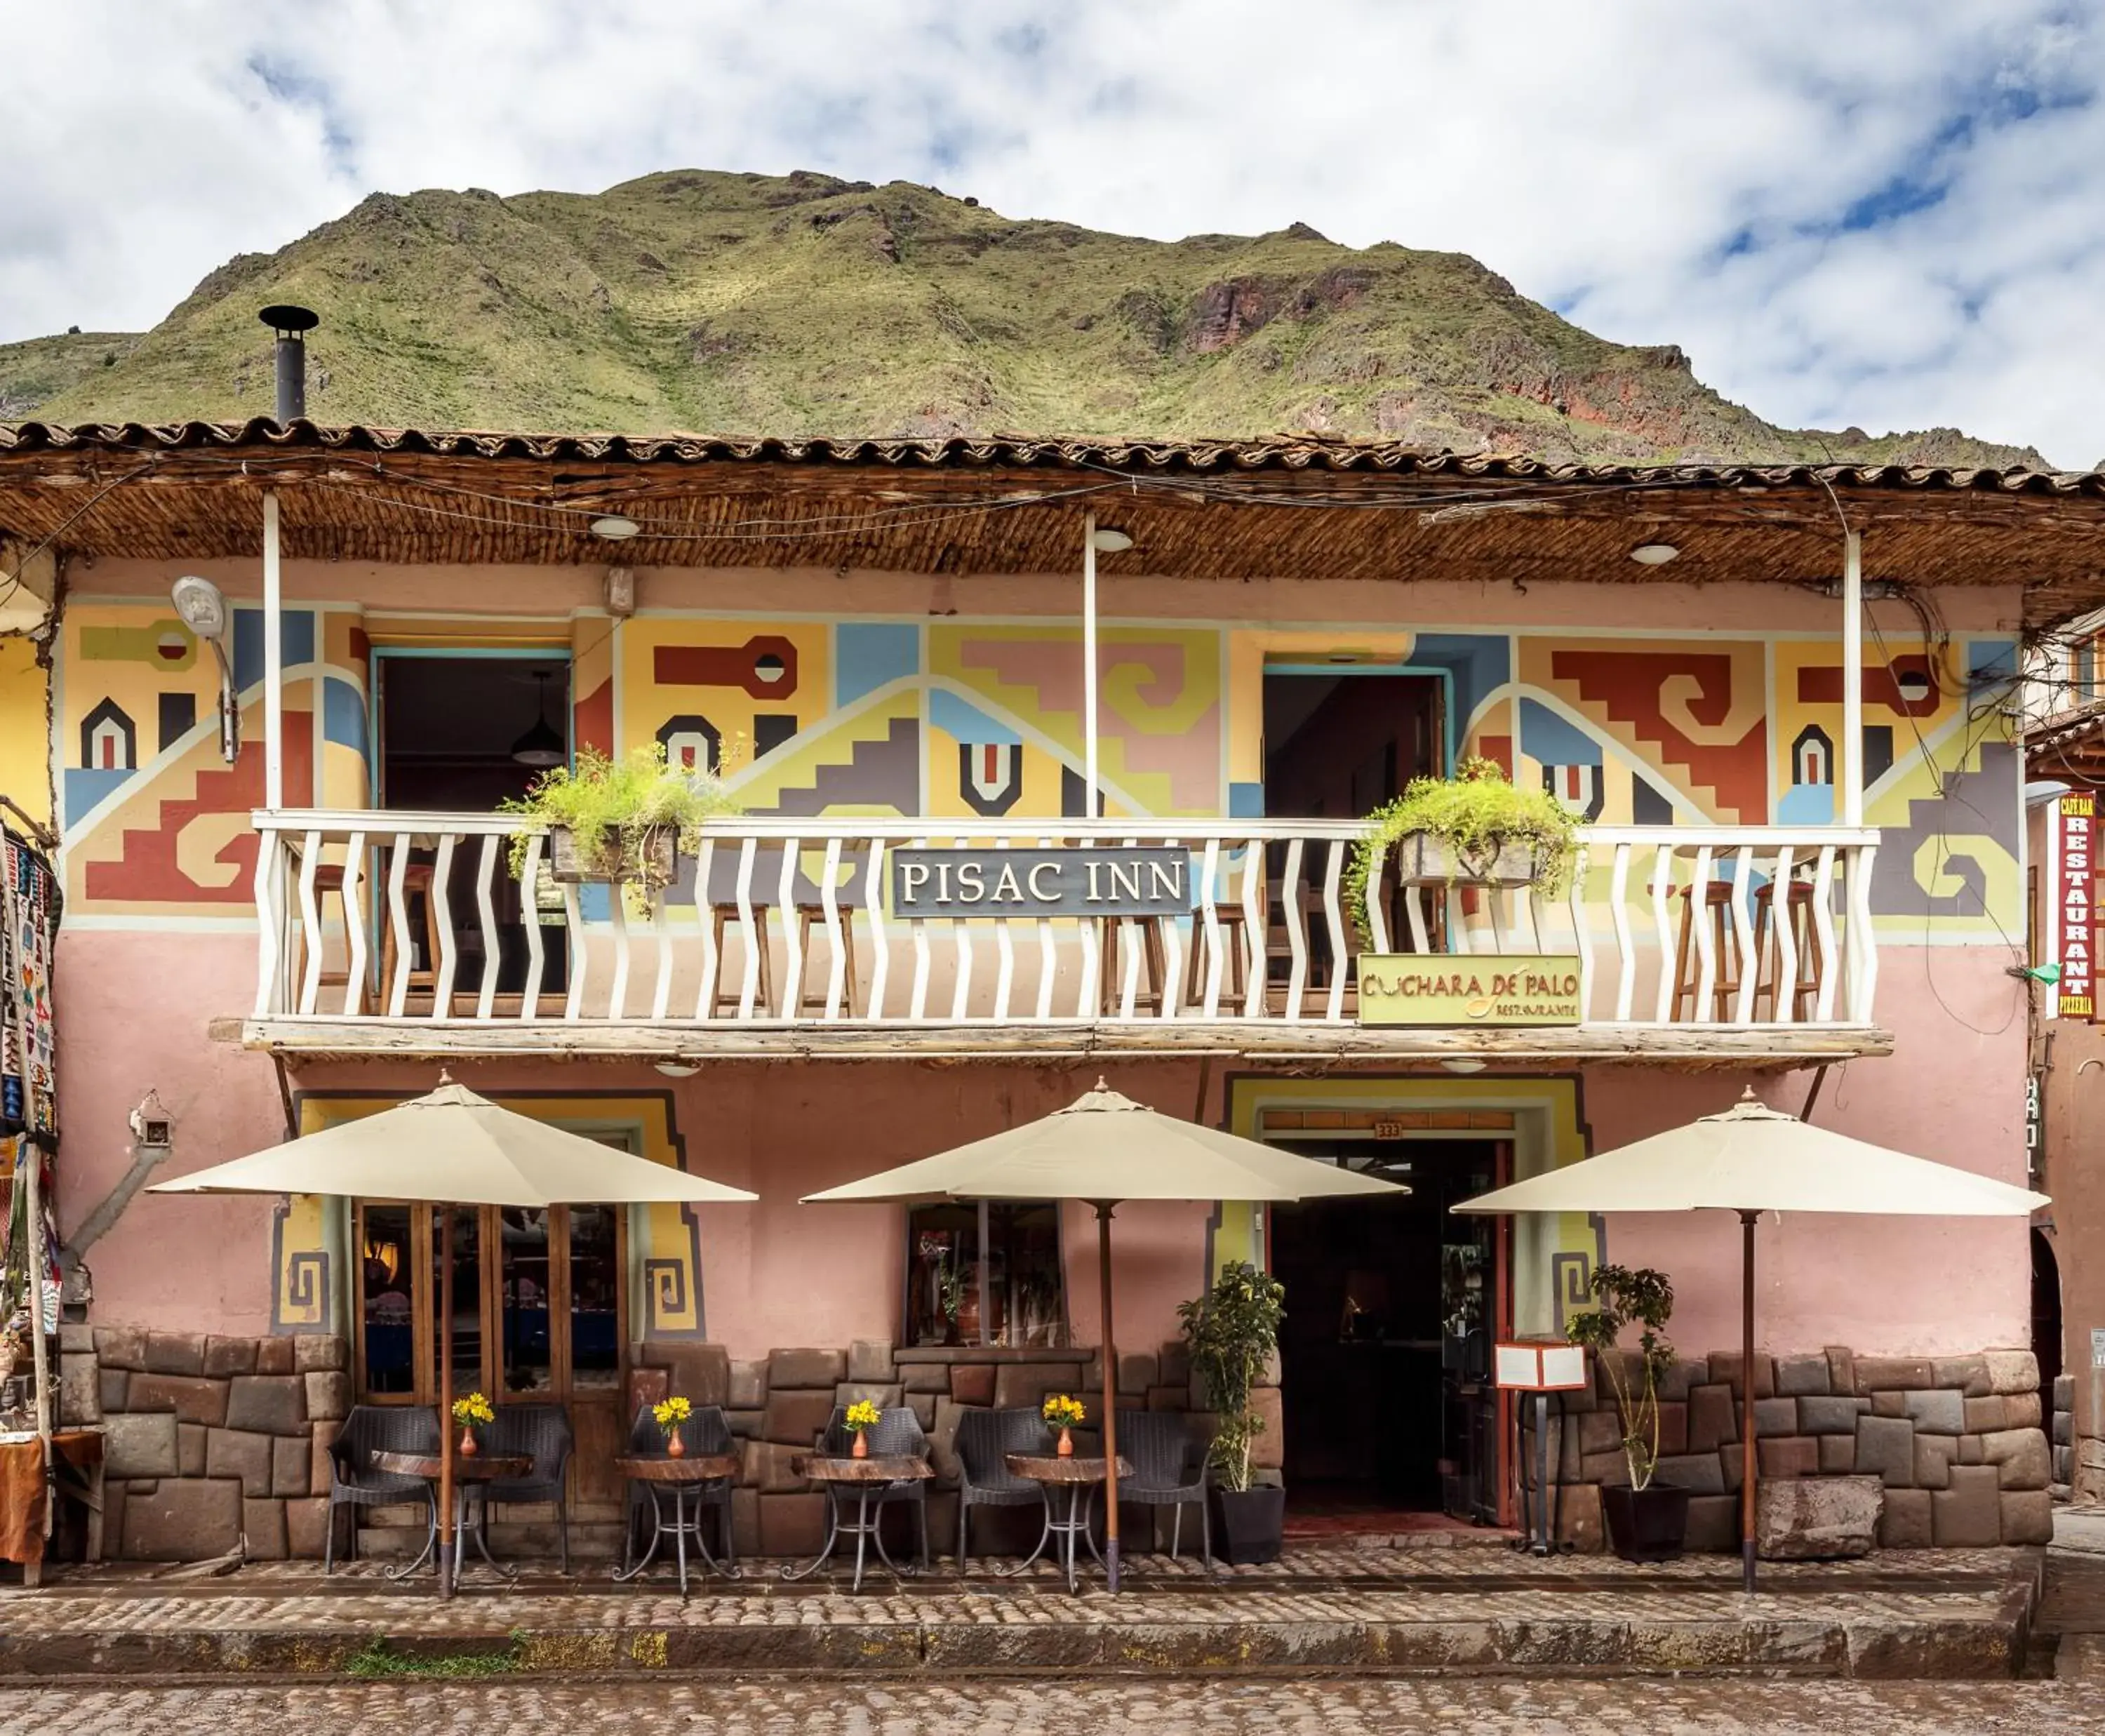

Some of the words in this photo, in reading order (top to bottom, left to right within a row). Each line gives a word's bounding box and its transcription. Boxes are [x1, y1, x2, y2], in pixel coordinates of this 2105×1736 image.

[2079, 798, 2094, 817] BAR
[900, 862, 1063, 903] PISAC
[1085, 860, 1184, 902] INN
[2065, 817, 2089, 994] RESTAURANT
[1363, 973, 1485, 997] CUCHARA
[1525, 973, 1578, 997] PALO
[1496, 1004, 1577, 1017] RESTAURANTE
[2059, 996, 2093, 1015] PIZZERIA
[1378, 1124, 1400, 1137] 333
